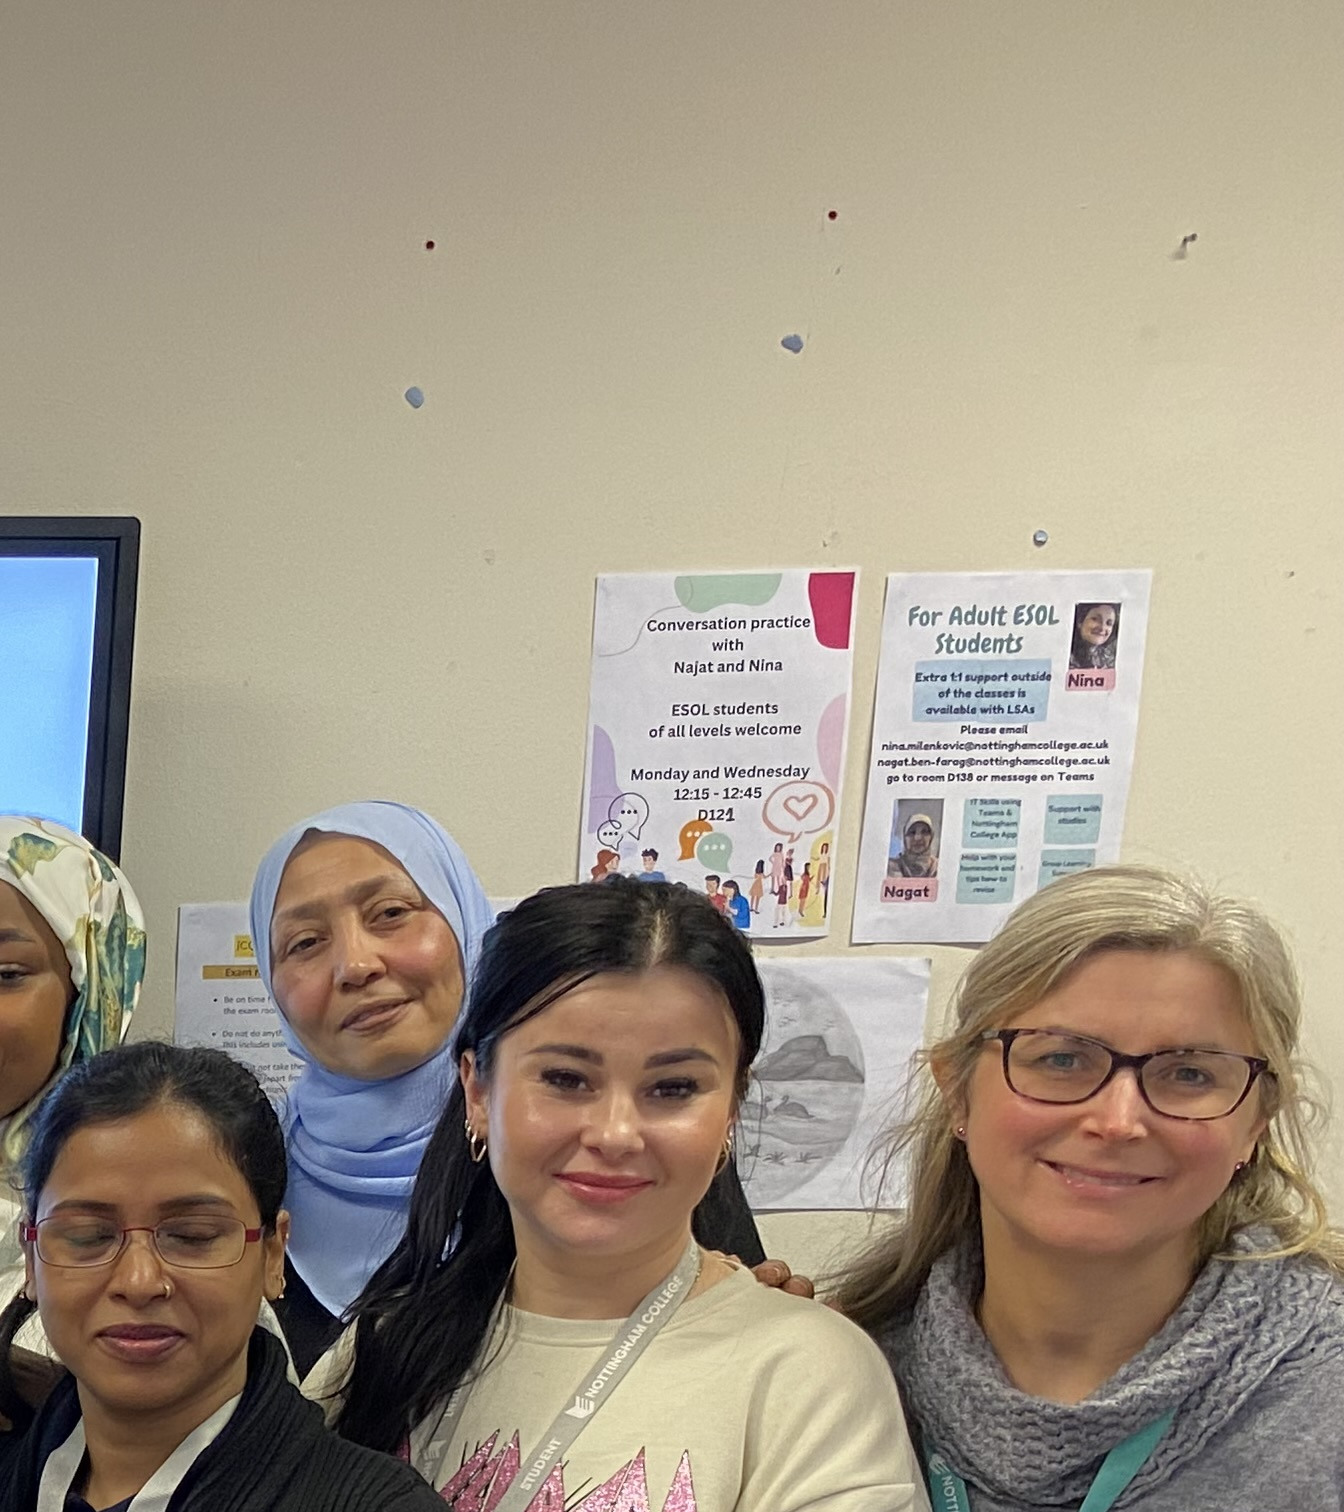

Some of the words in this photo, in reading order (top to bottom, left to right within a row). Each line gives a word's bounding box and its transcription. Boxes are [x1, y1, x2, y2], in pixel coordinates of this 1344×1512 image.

[908, 605, 942, 627] For
[948, 605, 1007, 626] Adult
[1012, 604, 1060, 626] ESOL
[647, 618, 747, 632] Conversation
[750, 616, 811, 632] practice
[712, 639, 744, 651] with
[934, 632, 1024, 655] Students
[717, 660, 745, 672] and
[749, 659, 783, 672] Nina
[915, 673, 947, 683] Extra
[964, 673, 1008, 685] support
[1011, 671, 1052, 682] outside
[1068, 673, 1104, 688] Nina
[938, 688, 951, 698] of
[953, 688, 972, 698] the
[974, 688, 1015, 698] classes
[1017, 688, 1026, 698] is
[671, 704, 710, 716] ESOL
[713, 702, 779, 715] students
[925, 704, 977, 715] available
[980, 704, 1004, 715] with
[1007, 705, 1035, 715] LSAs
[648, 725, 665, 738] of
[668, 724, 685, 737] all
[688, 724, 731, 737] levels
[735, 723, 802, 736] welcome
[960, 725, 996, 735] Please
[999, 724, 1028, 735] email
[630, 768, 690, 783] Monday
[692, 767, 720, 780] and
[724, 765, 810, 781] Wednesday
[886, 774, 900, 784] go
[902, 773, 914, 782] to
[917, 773, 945, 782] room
[976, 773, 988, 782] or
[991, 773, 1037, 784] message
[1040, 773, 1054, 782] on
[1058, 771, 1094, 782] Teams
[674, 788, 710, 800] 12:15
[723, 787, 762, 799] 12:45
[884, 886, 930, 900] Nagat
[225, 968, 252, 978] Exam
[585, 1324, 647, 1398] NOTTINGHAM
[641, 1274, 683, 1325] COLLEGE
[519, 1438, 562, 1491] STUDENT
